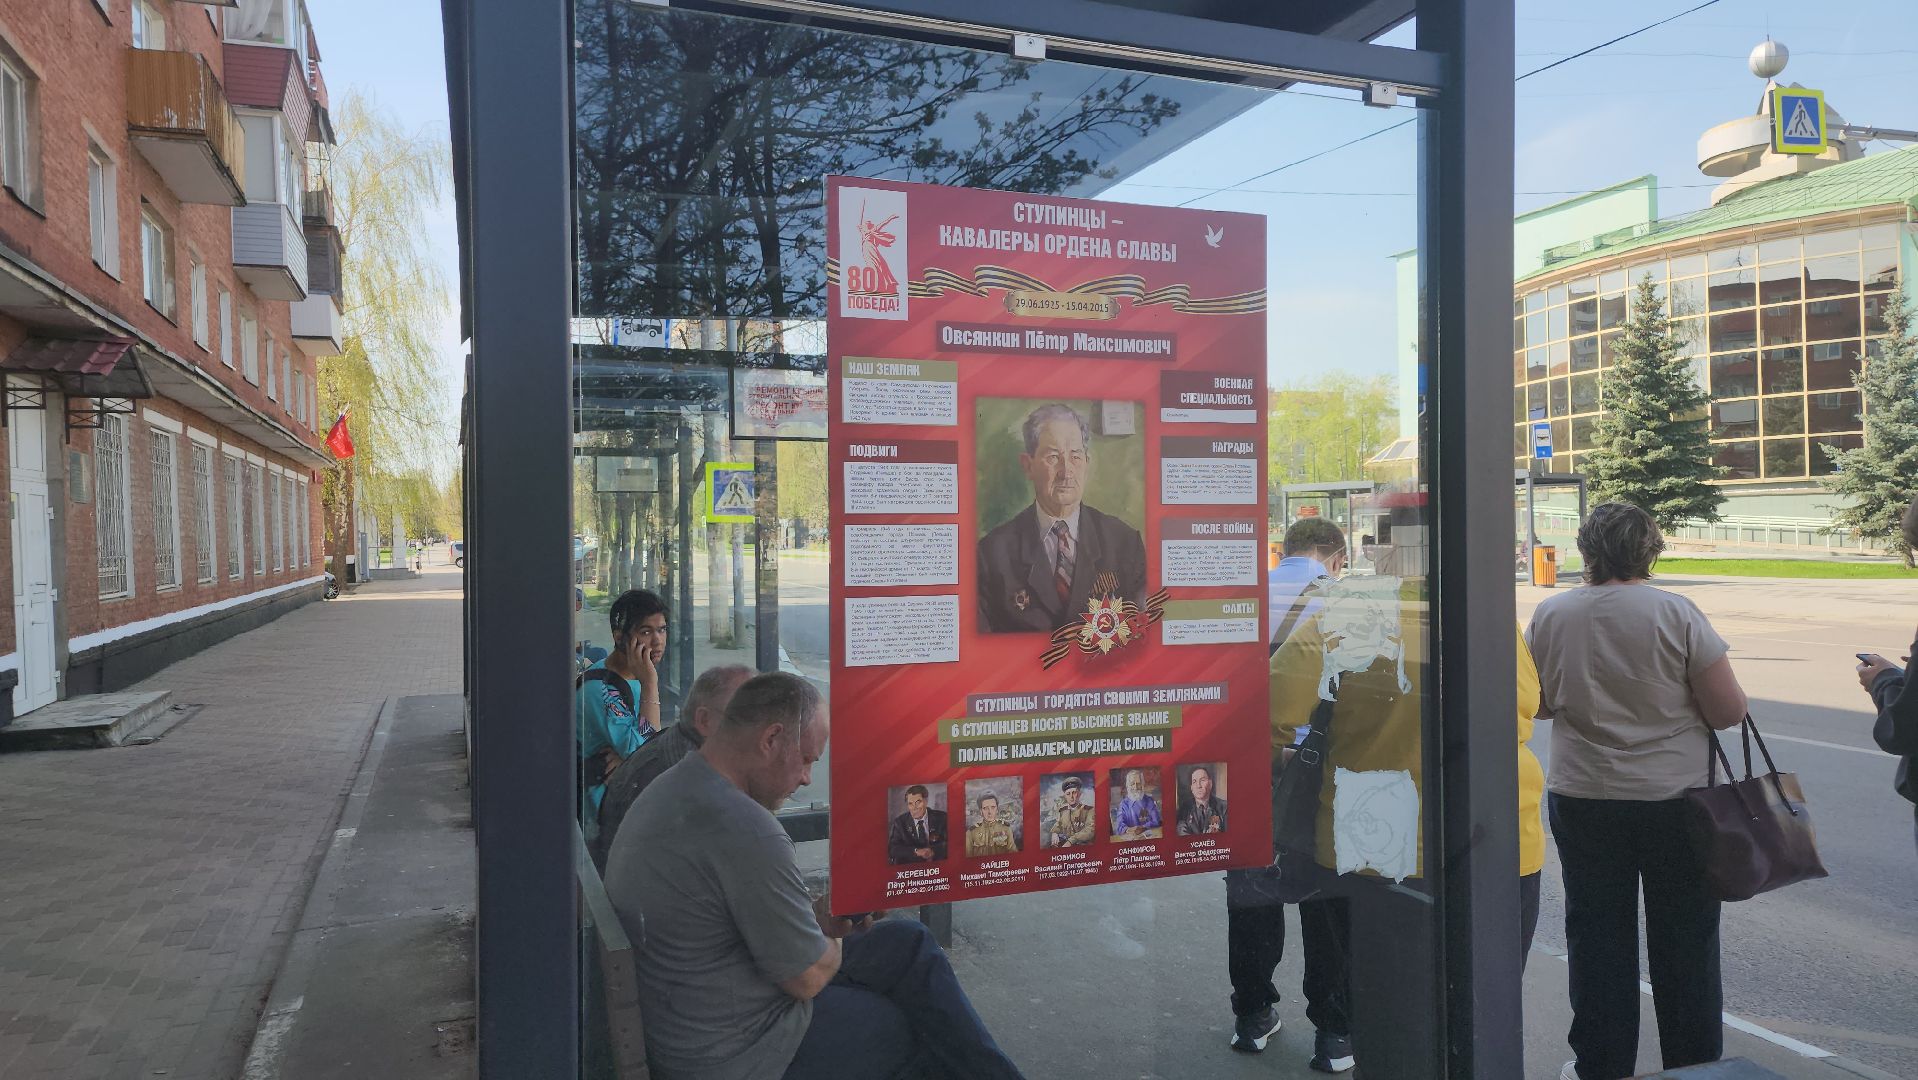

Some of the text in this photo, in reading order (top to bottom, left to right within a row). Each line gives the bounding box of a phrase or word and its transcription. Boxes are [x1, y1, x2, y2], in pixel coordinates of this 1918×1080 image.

[1013, 201, 1106, 232] СТУПИНЦЫ
[939, 225, 1177, 262] КАВАЛЕРЫ ОРДЕНА СЛАВЫ
[847, 265, 877, 292] 80
[847, 296, 900, 312] ПОБЕДА!
[1066, 302, 1109, 313] 15.04.2015
[942, 326, 1171, 354] Овсянкин Пётр Максимович
[848, 362, 920, 376] НАШ ЗЕМЛЯК
[1214, 377, 1254, 390] ВОЕННАЯ
[1180, 392, 1254, 406] СПЕЦИАЛЬНОСТЬ
[849, 444, 898, 459] ПОДВИГИ
[1212, 441, 1254, 455] НАГРАДЫ
[1191, 521, 1254, 535] ПОСЛЕ ВОЙНЫ
[1222, 603, 1255, 614] ФАКТЫ
[975, 686, 1221, 713] СТУПИНЦЫ ГОРДЯТСЯ СВОИМИ ЗЕМЛЯКАМИ
[951, 710, 1170, 738] 6 СТУПИНЦЕВ НОСЯТ ВЫСОКОЕ ЗВАНИЕ
[958, 735, 1164, 763] ПОЛНЫЕ КАВАЛЕРЫ ОРДЕНА СЛАВЫ
[1051, 852, 1086, 862] НОВИКОВ
[980, 860, 1010, 870] ЗАЙЦЕВ
[960, 872, 987, 881] Михаил
